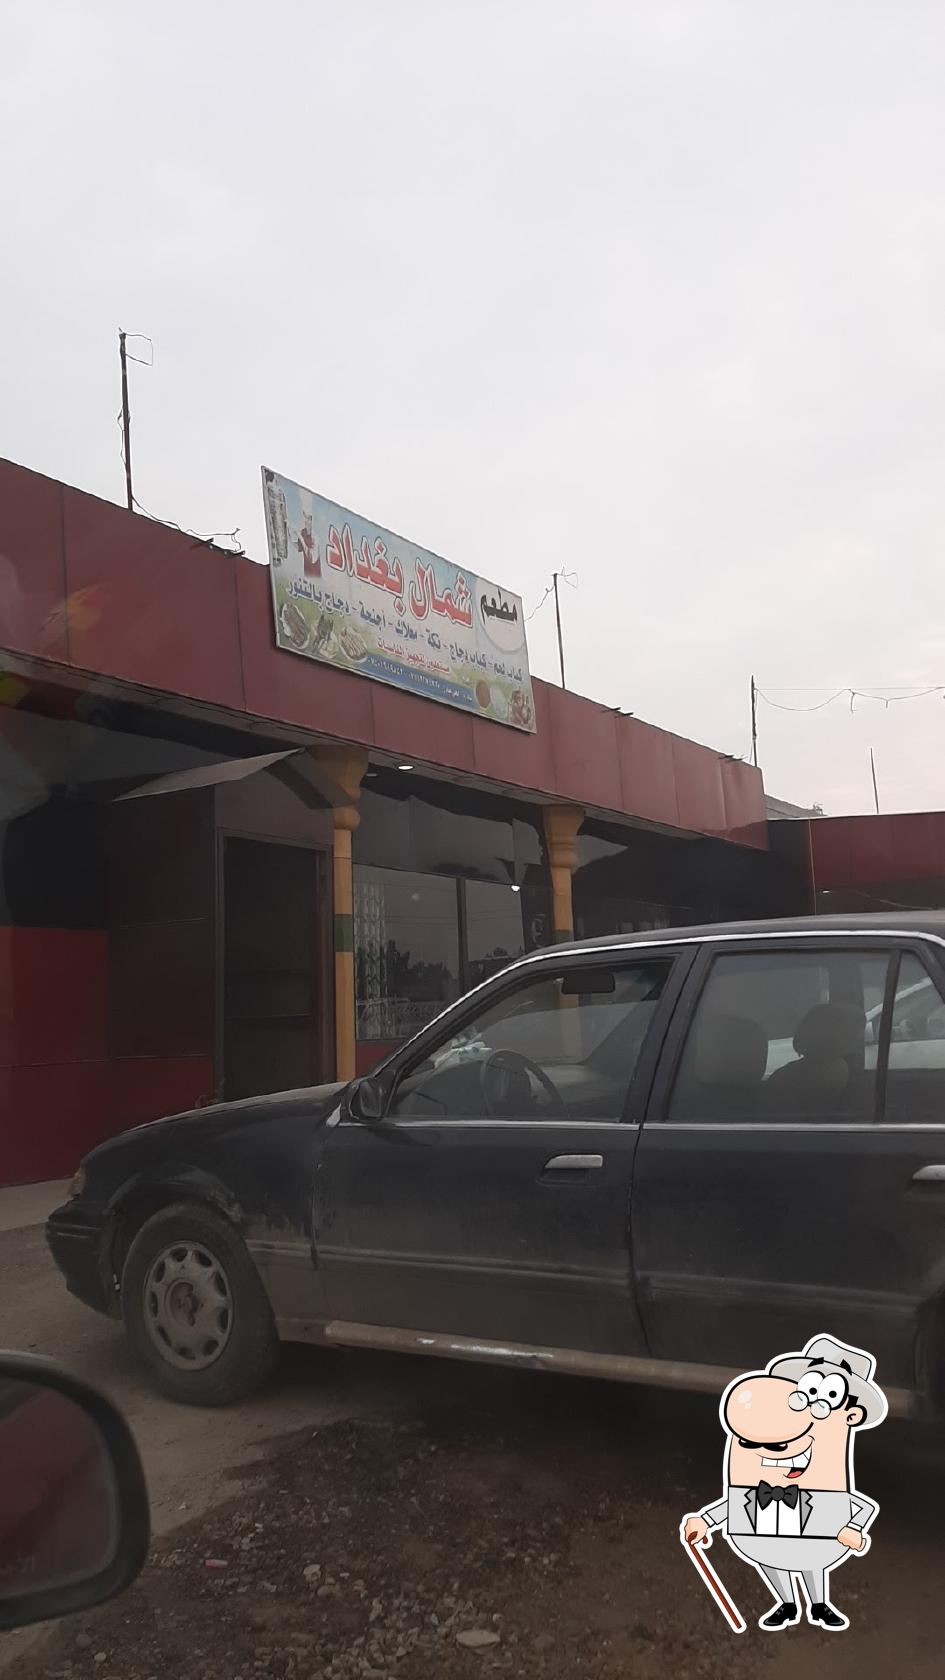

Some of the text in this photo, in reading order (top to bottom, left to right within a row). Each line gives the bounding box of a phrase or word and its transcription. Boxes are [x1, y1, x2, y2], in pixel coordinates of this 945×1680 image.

[326, 523, 518, 628] مطعم شمال بغداد
[287, 577, 322, 611] بالتنور
[325, 591, 350, 616] دجاج
[395, 619, 418, 641] معلاك
[449, 642, 468, 664] دجاج
[470, 652, 487, 669] كباب
